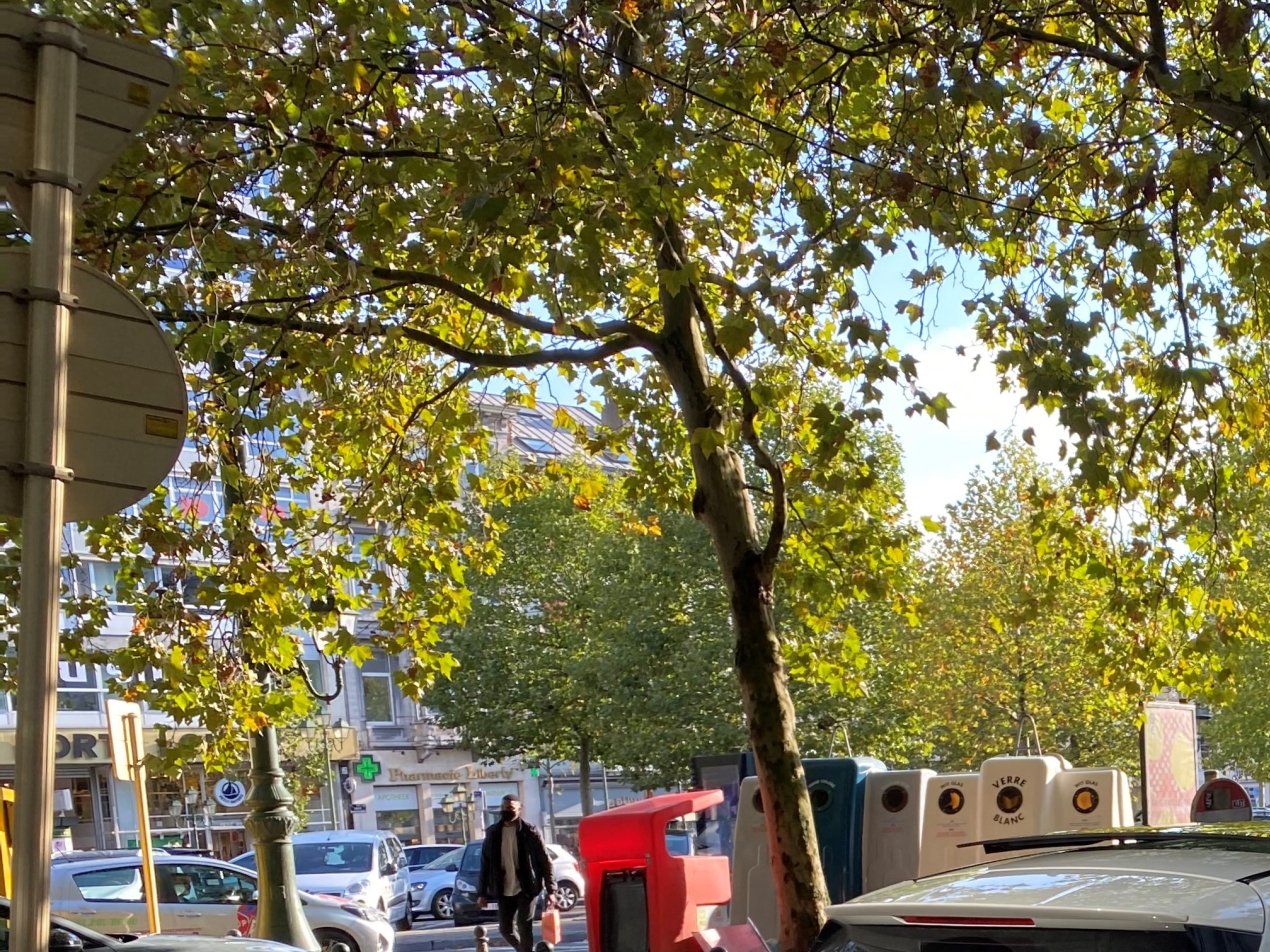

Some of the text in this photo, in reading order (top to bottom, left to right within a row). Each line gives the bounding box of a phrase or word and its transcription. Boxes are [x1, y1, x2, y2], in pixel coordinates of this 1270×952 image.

[388, 768, 461, 782] Pharmacie
[992, 776, 1027, 789] VERRE
[993, 813, 1025, 825] BLANC
